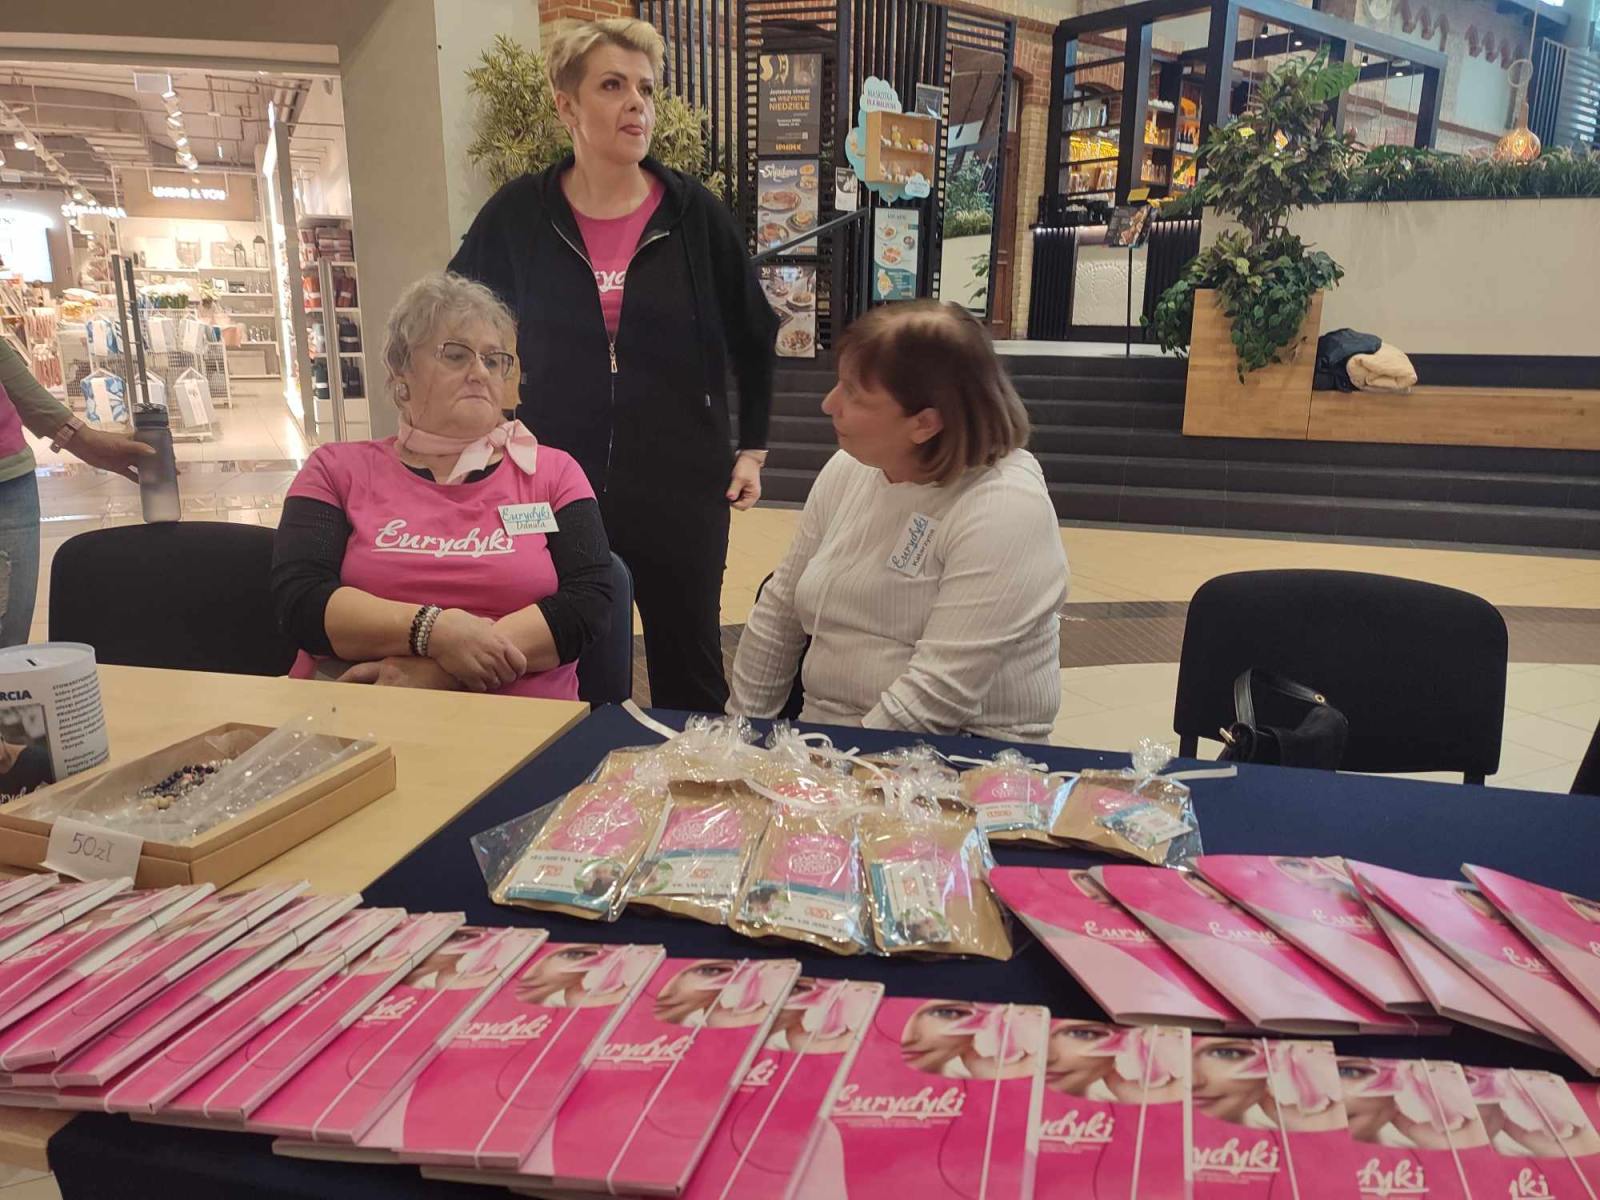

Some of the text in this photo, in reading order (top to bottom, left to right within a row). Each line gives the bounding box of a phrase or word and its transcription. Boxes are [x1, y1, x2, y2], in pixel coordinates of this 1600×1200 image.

[769, 102, 810, 111] NIEDZIELE
[502, 506, 550, 523] Eurydyki
[375, 519, 514, 558] Eurydyki
[831, 1083, 966, 1120] Eurydyki
